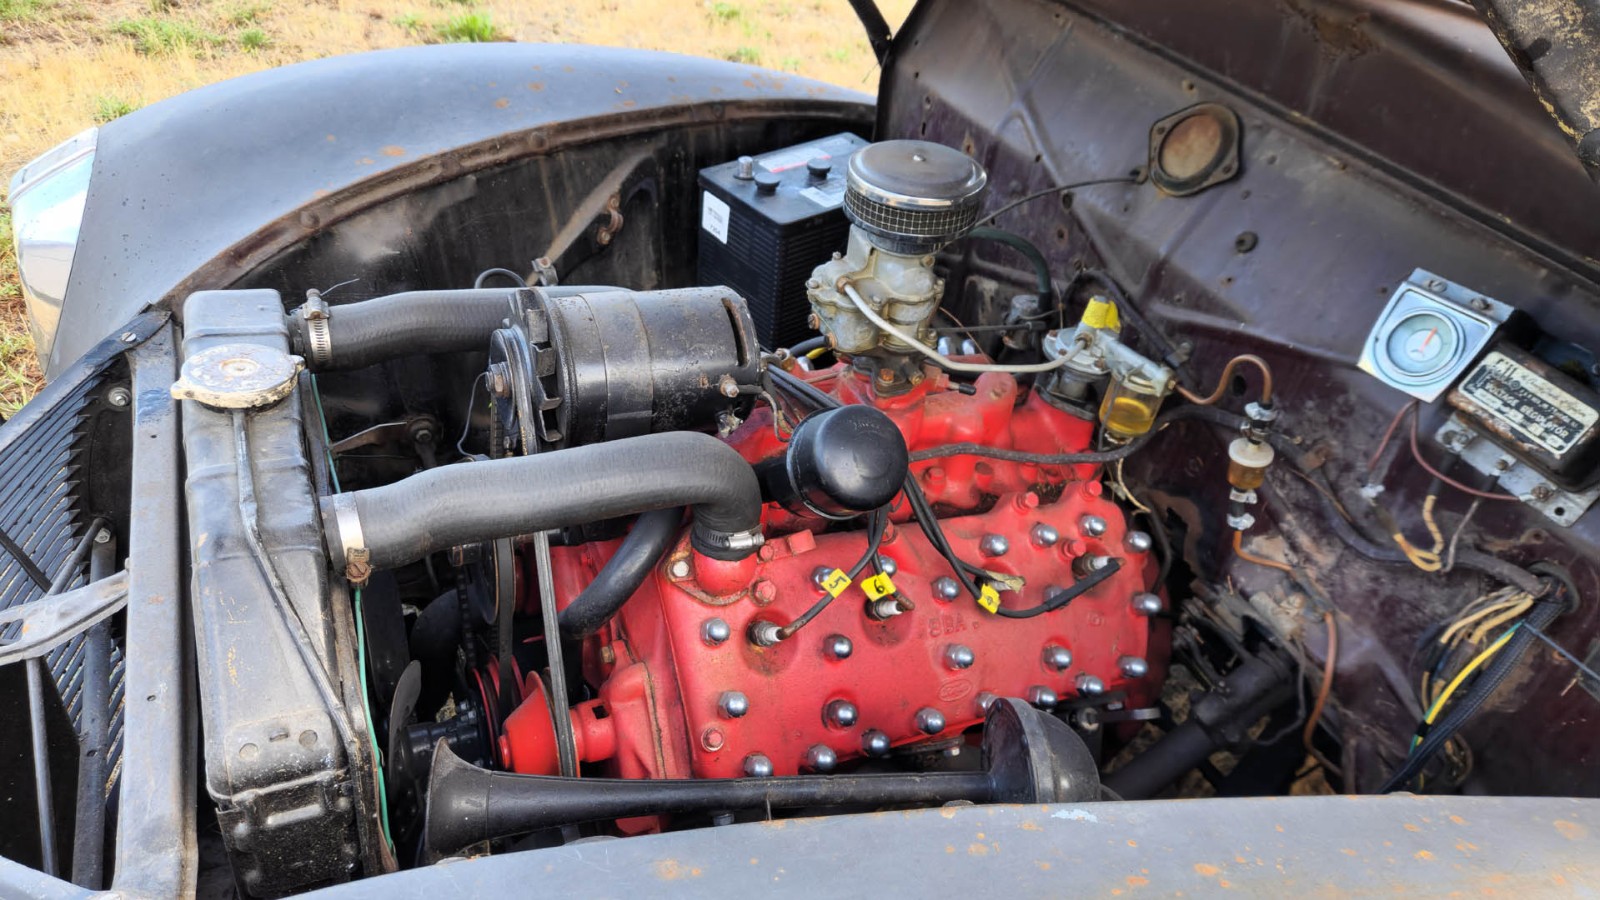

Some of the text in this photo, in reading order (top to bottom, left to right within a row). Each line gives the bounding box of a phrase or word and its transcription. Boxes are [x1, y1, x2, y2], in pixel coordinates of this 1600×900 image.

[1484, 382, 1520, 407] VOLTAGE
[1520, 404, 1570, 439] REGULATOR
[873, 578, 885, 594] 6
